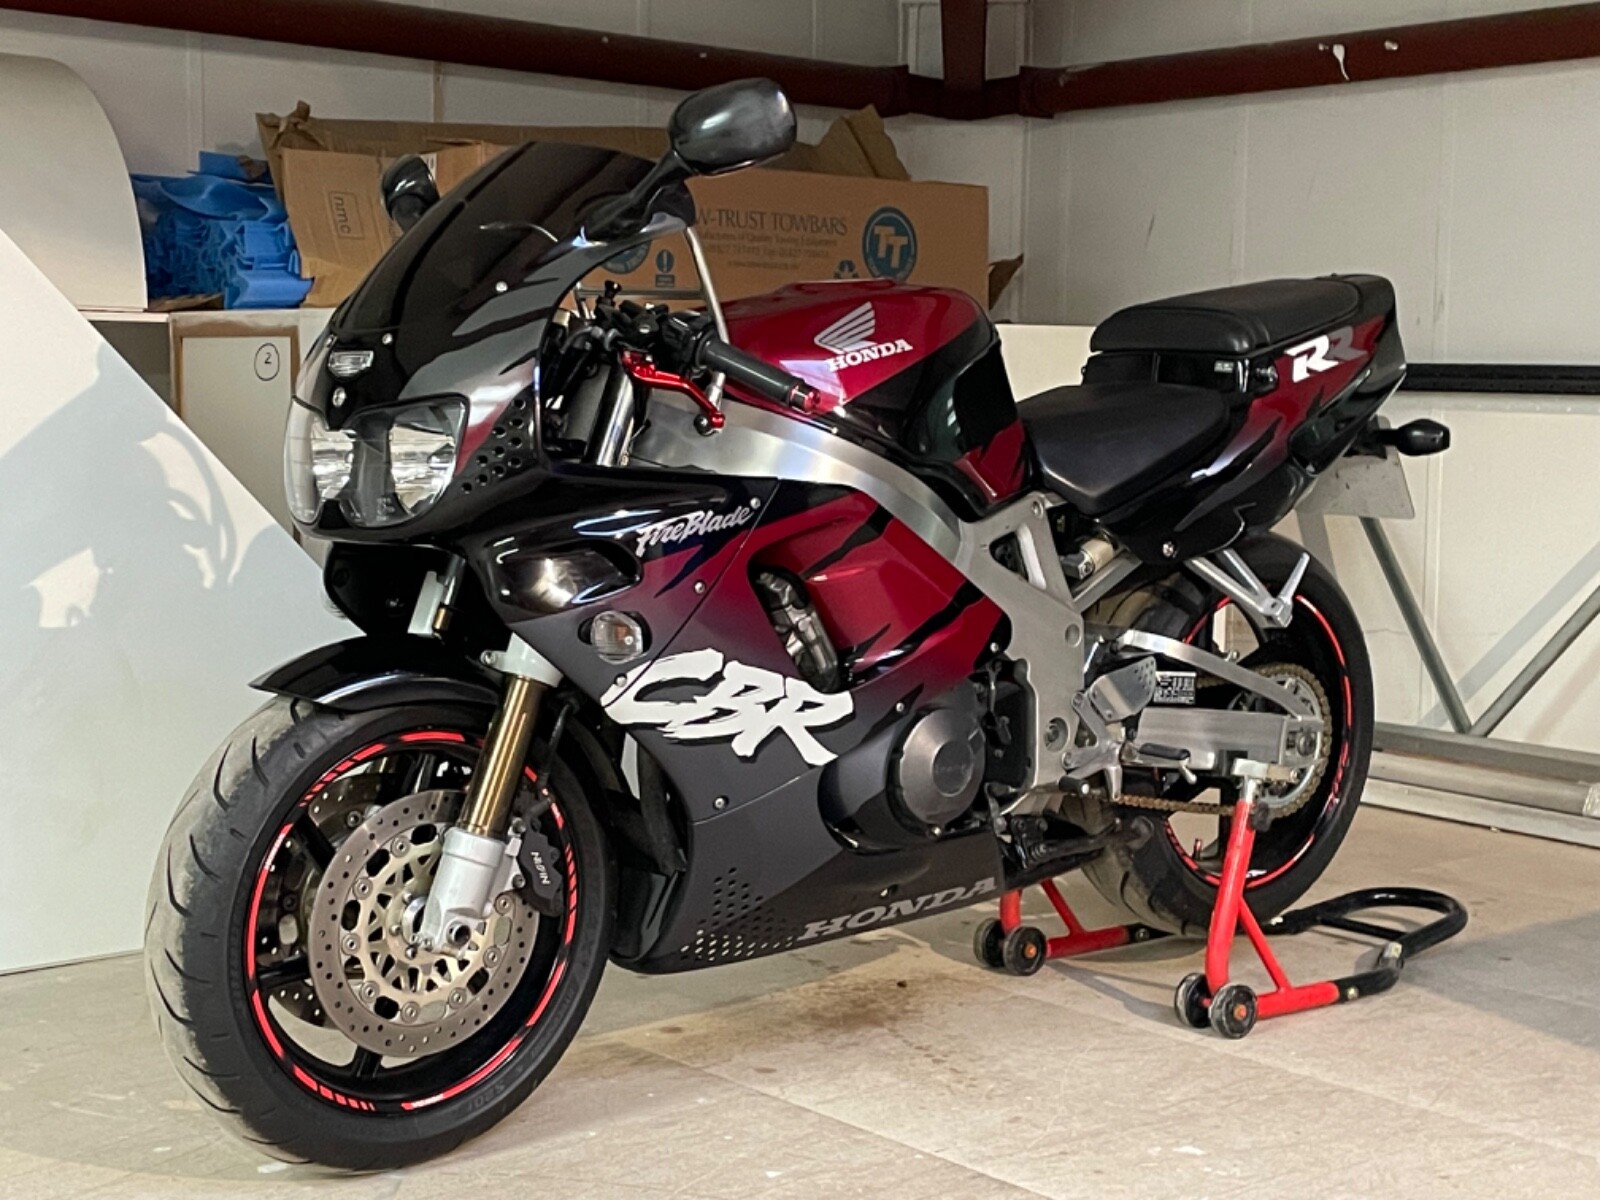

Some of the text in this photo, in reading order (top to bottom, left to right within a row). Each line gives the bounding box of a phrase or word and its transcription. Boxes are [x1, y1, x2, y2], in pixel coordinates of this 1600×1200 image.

[333, 196, 351, 234] nmc
[771, 211, 849, 235] TOWBARS
[874, 224, 908, 268] TT
[264, 351, 273, 365] 2
[824, 338, 913, 372] HONDA
[1284, 326, 1368, 383] RR
[635, 505, 753, 557] FireBlade
[600, 648, 854, 766] CBR
[797, 877, 997, 942] HONDA
